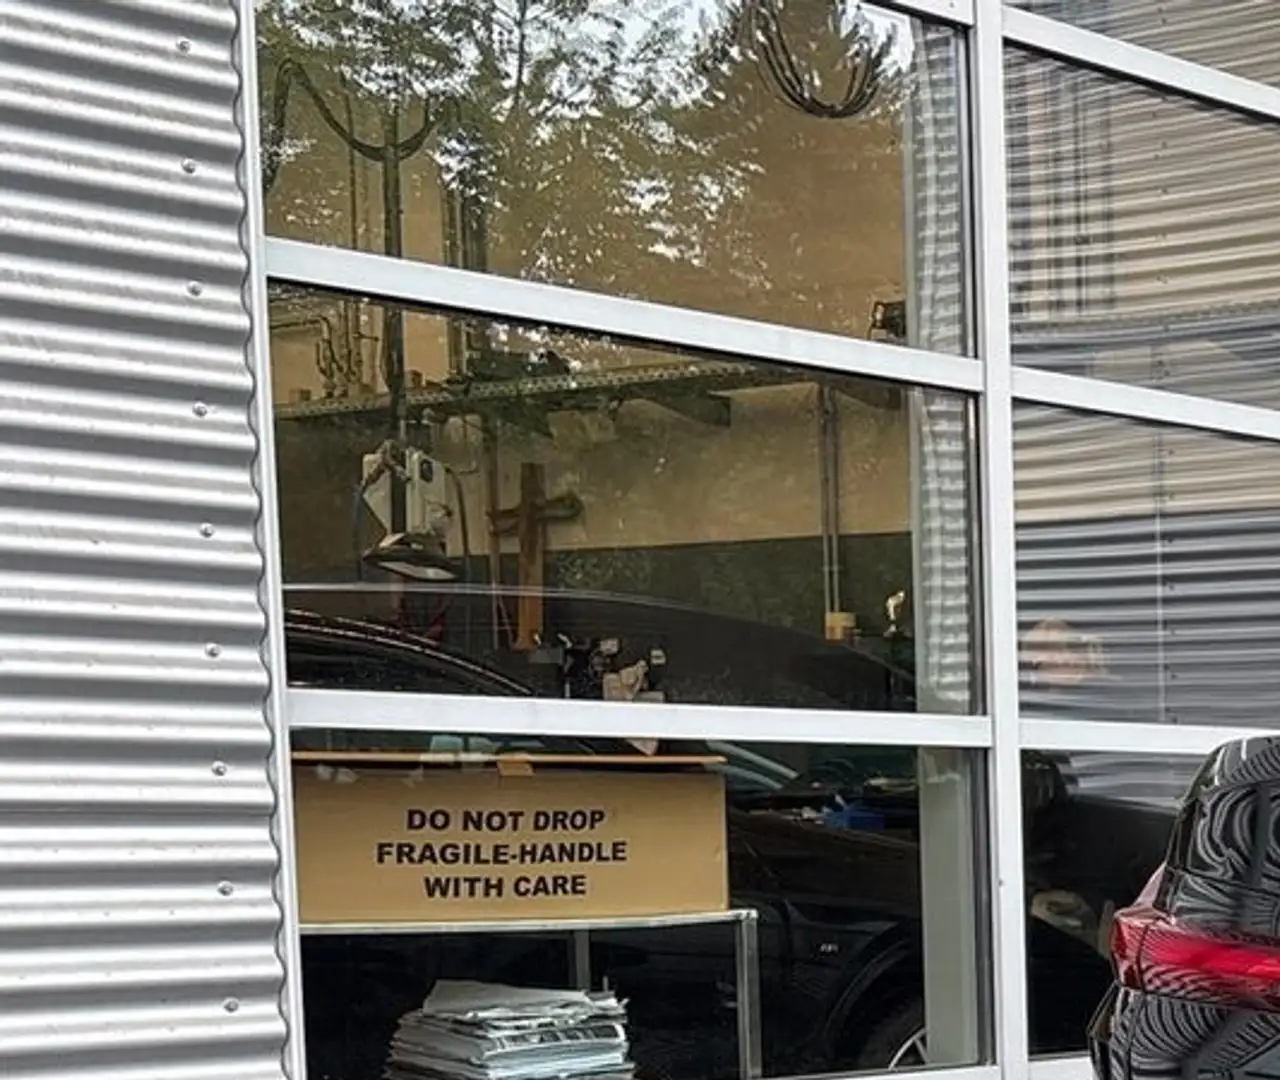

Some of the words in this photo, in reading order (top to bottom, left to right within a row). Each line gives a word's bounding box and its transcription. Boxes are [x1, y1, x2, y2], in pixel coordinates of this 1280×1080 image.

[406, 808, 450, 831] DO
[462, 810, 524, 832] NOT
[533, 810, 605, 831] DROP
[376, 841, 628, 865] FRAGILE-HANDLE
[424, 876, 504, 898] WITH
[513, 875, 587, 897] CARE
